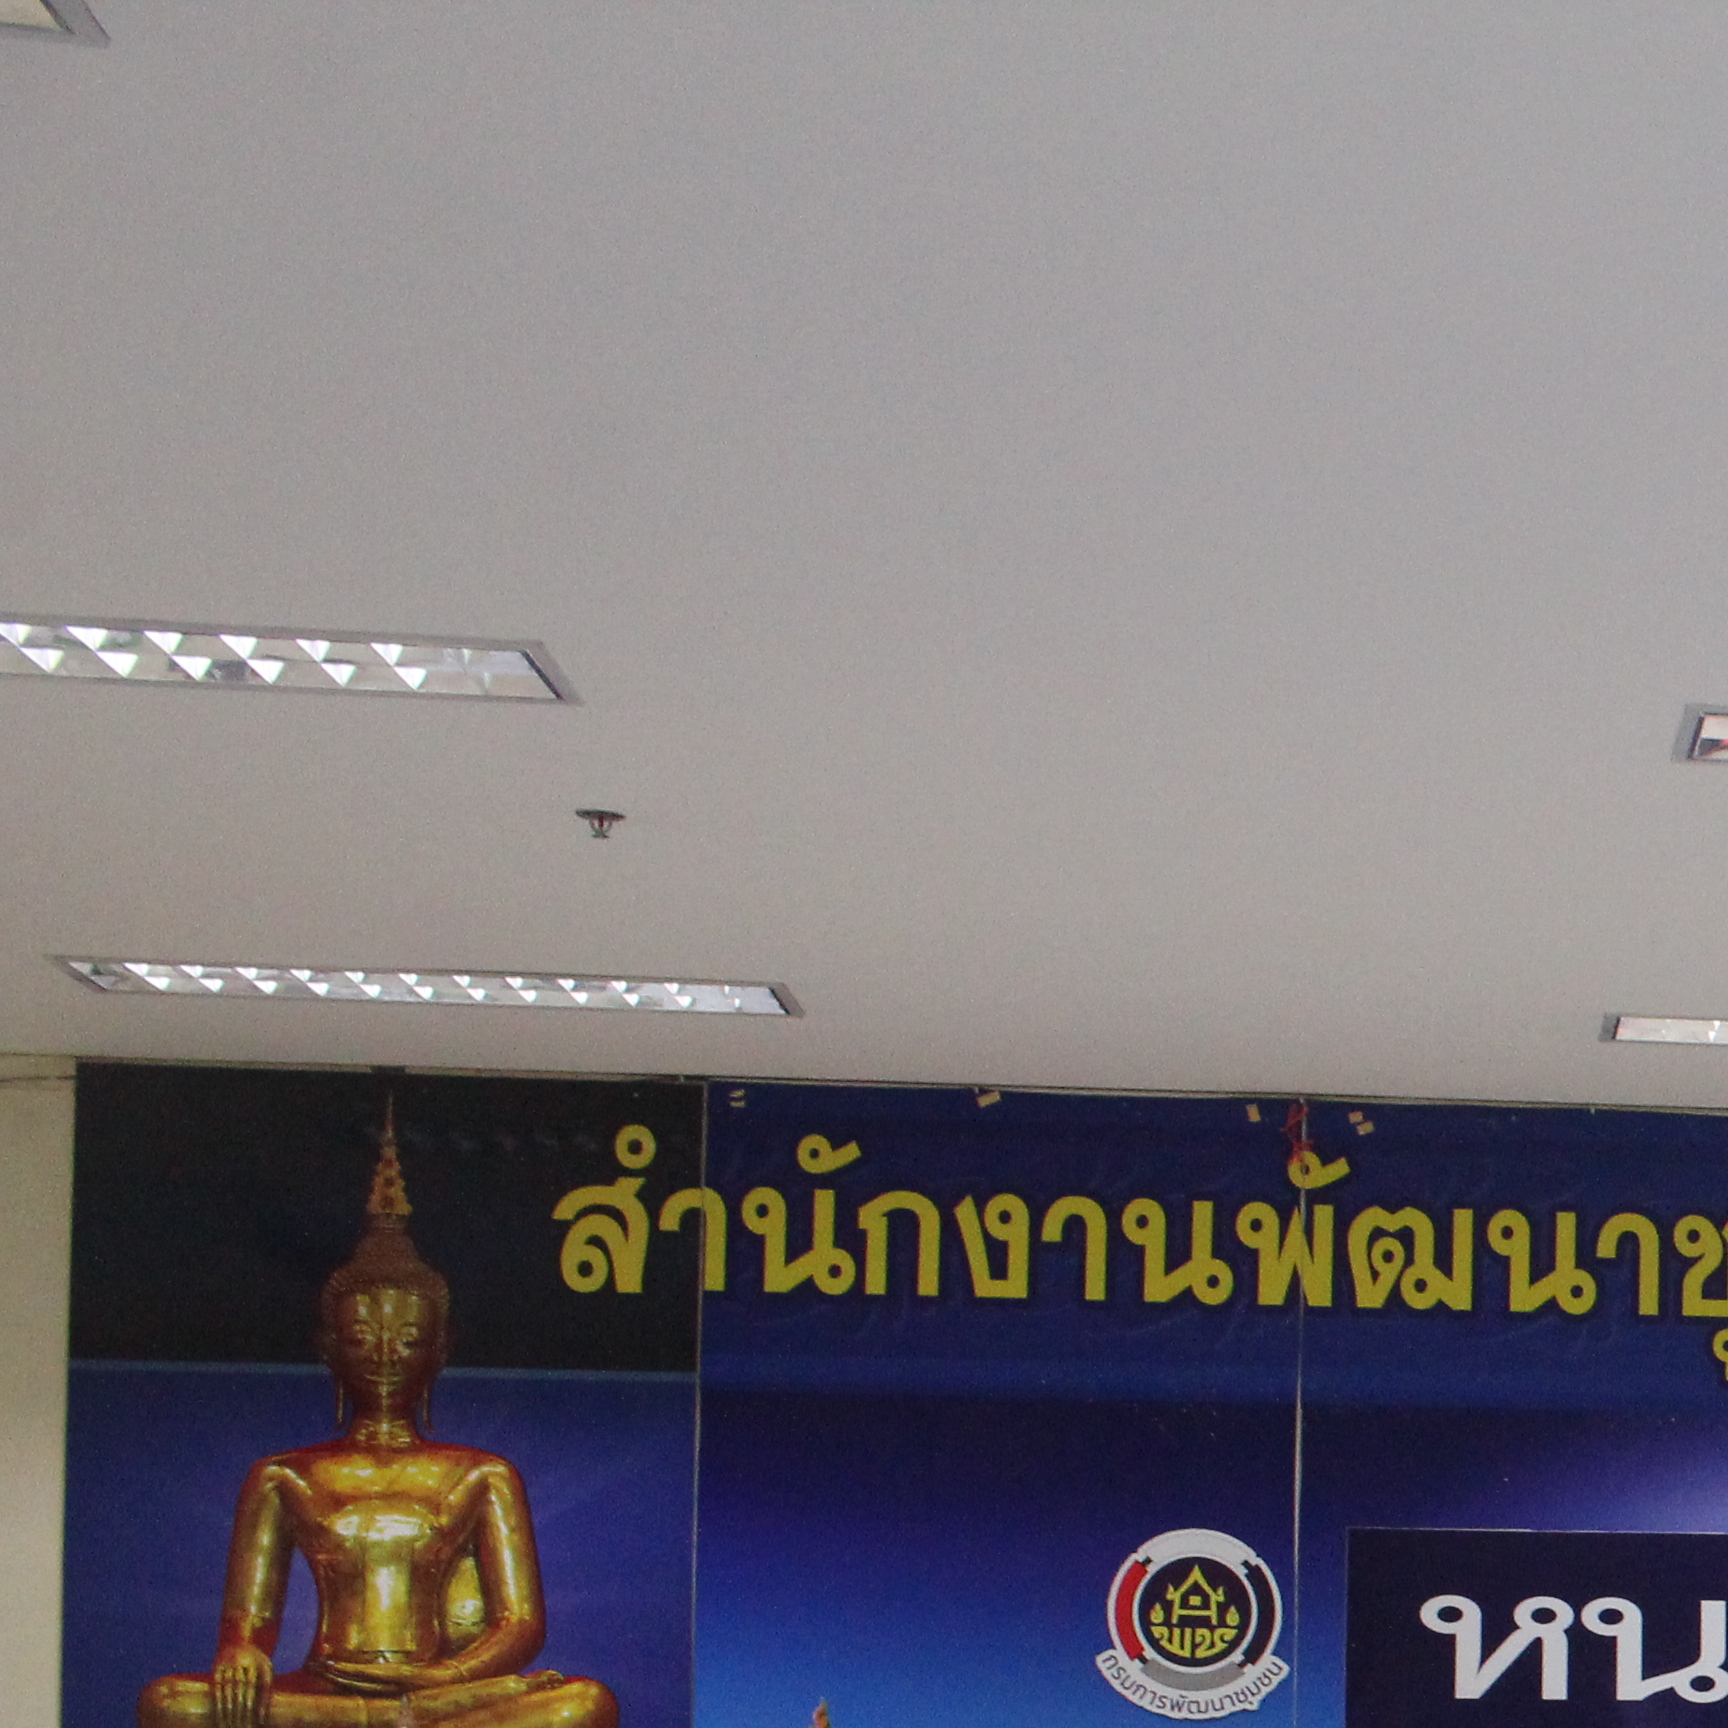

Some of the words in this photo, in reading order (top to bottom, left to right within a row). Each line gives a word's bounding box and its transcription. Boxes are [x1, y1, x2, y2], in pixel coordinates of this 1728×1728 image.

[1102, 1654, 1283, 1714] กรมการพัฒนาชุมชน
